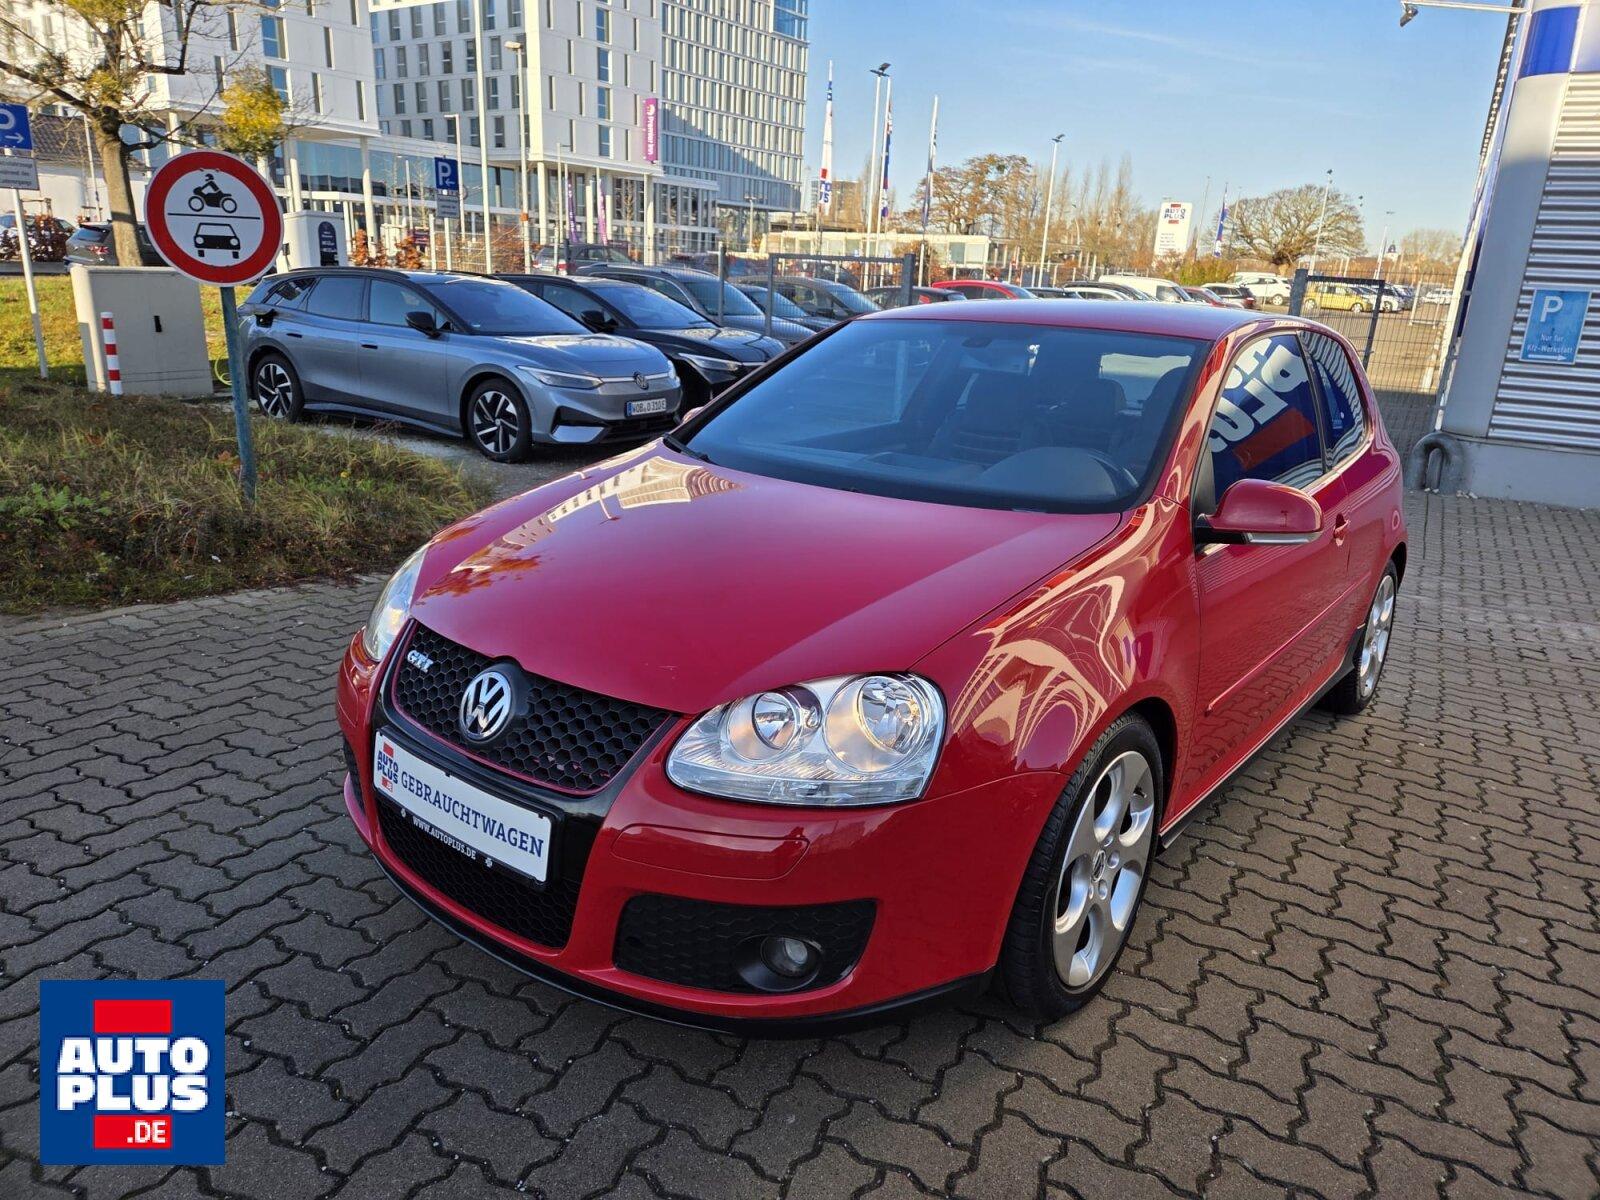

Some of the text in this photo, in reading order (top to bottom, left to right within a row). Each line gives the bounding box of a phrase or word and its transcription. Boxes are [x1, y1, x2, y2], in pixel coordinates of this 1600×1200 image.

[438, 161, 451, 186] P
[1540, 295, 1563, 322] P
[407, 650, 434, 673] GTI
[377, 750, 399, 773] AUTO
[377, 761, 399, 784] PLUS
[401, 771, 544, 858] GEBRAUCHTWAGEN
[412, 815, 477, 860] WWW.AUTOPLUS.DE
